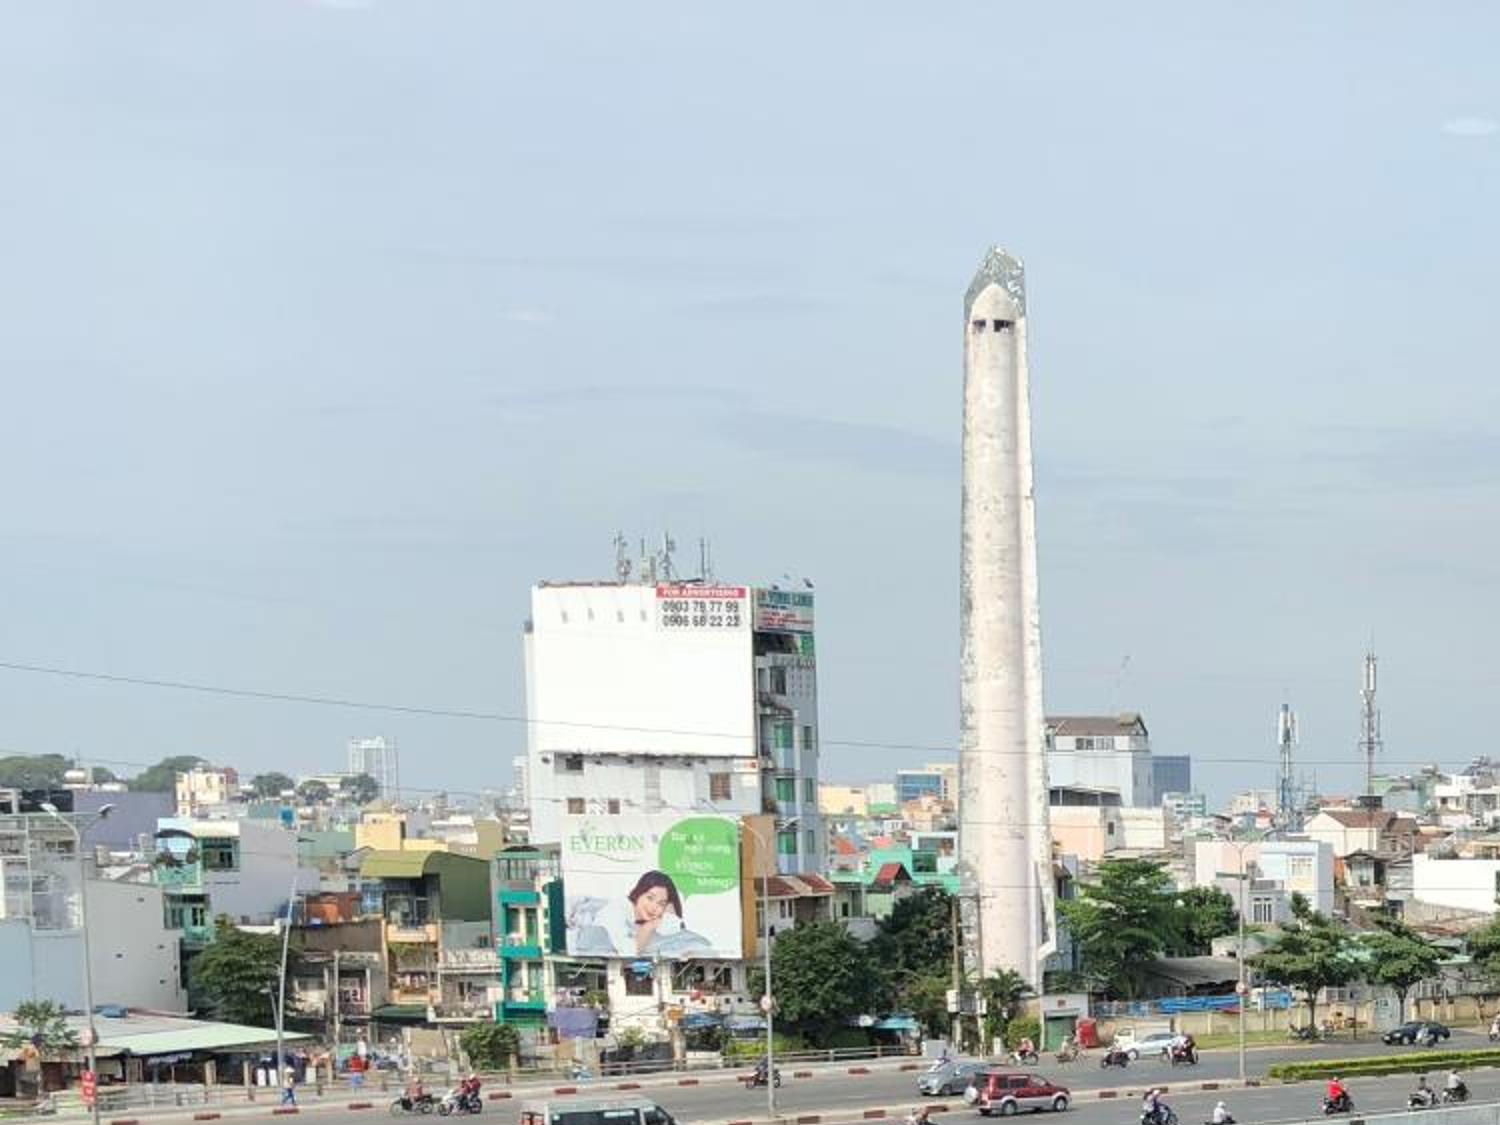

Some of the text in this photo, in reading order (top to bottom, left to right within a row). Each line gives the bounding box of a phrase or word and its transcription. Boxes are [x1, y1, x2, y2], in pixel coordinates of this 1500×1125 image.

[709, 600, 723, 613] 77
[709, 615, 723, 627] 22
[570, 835, 645, 851] EVERON
